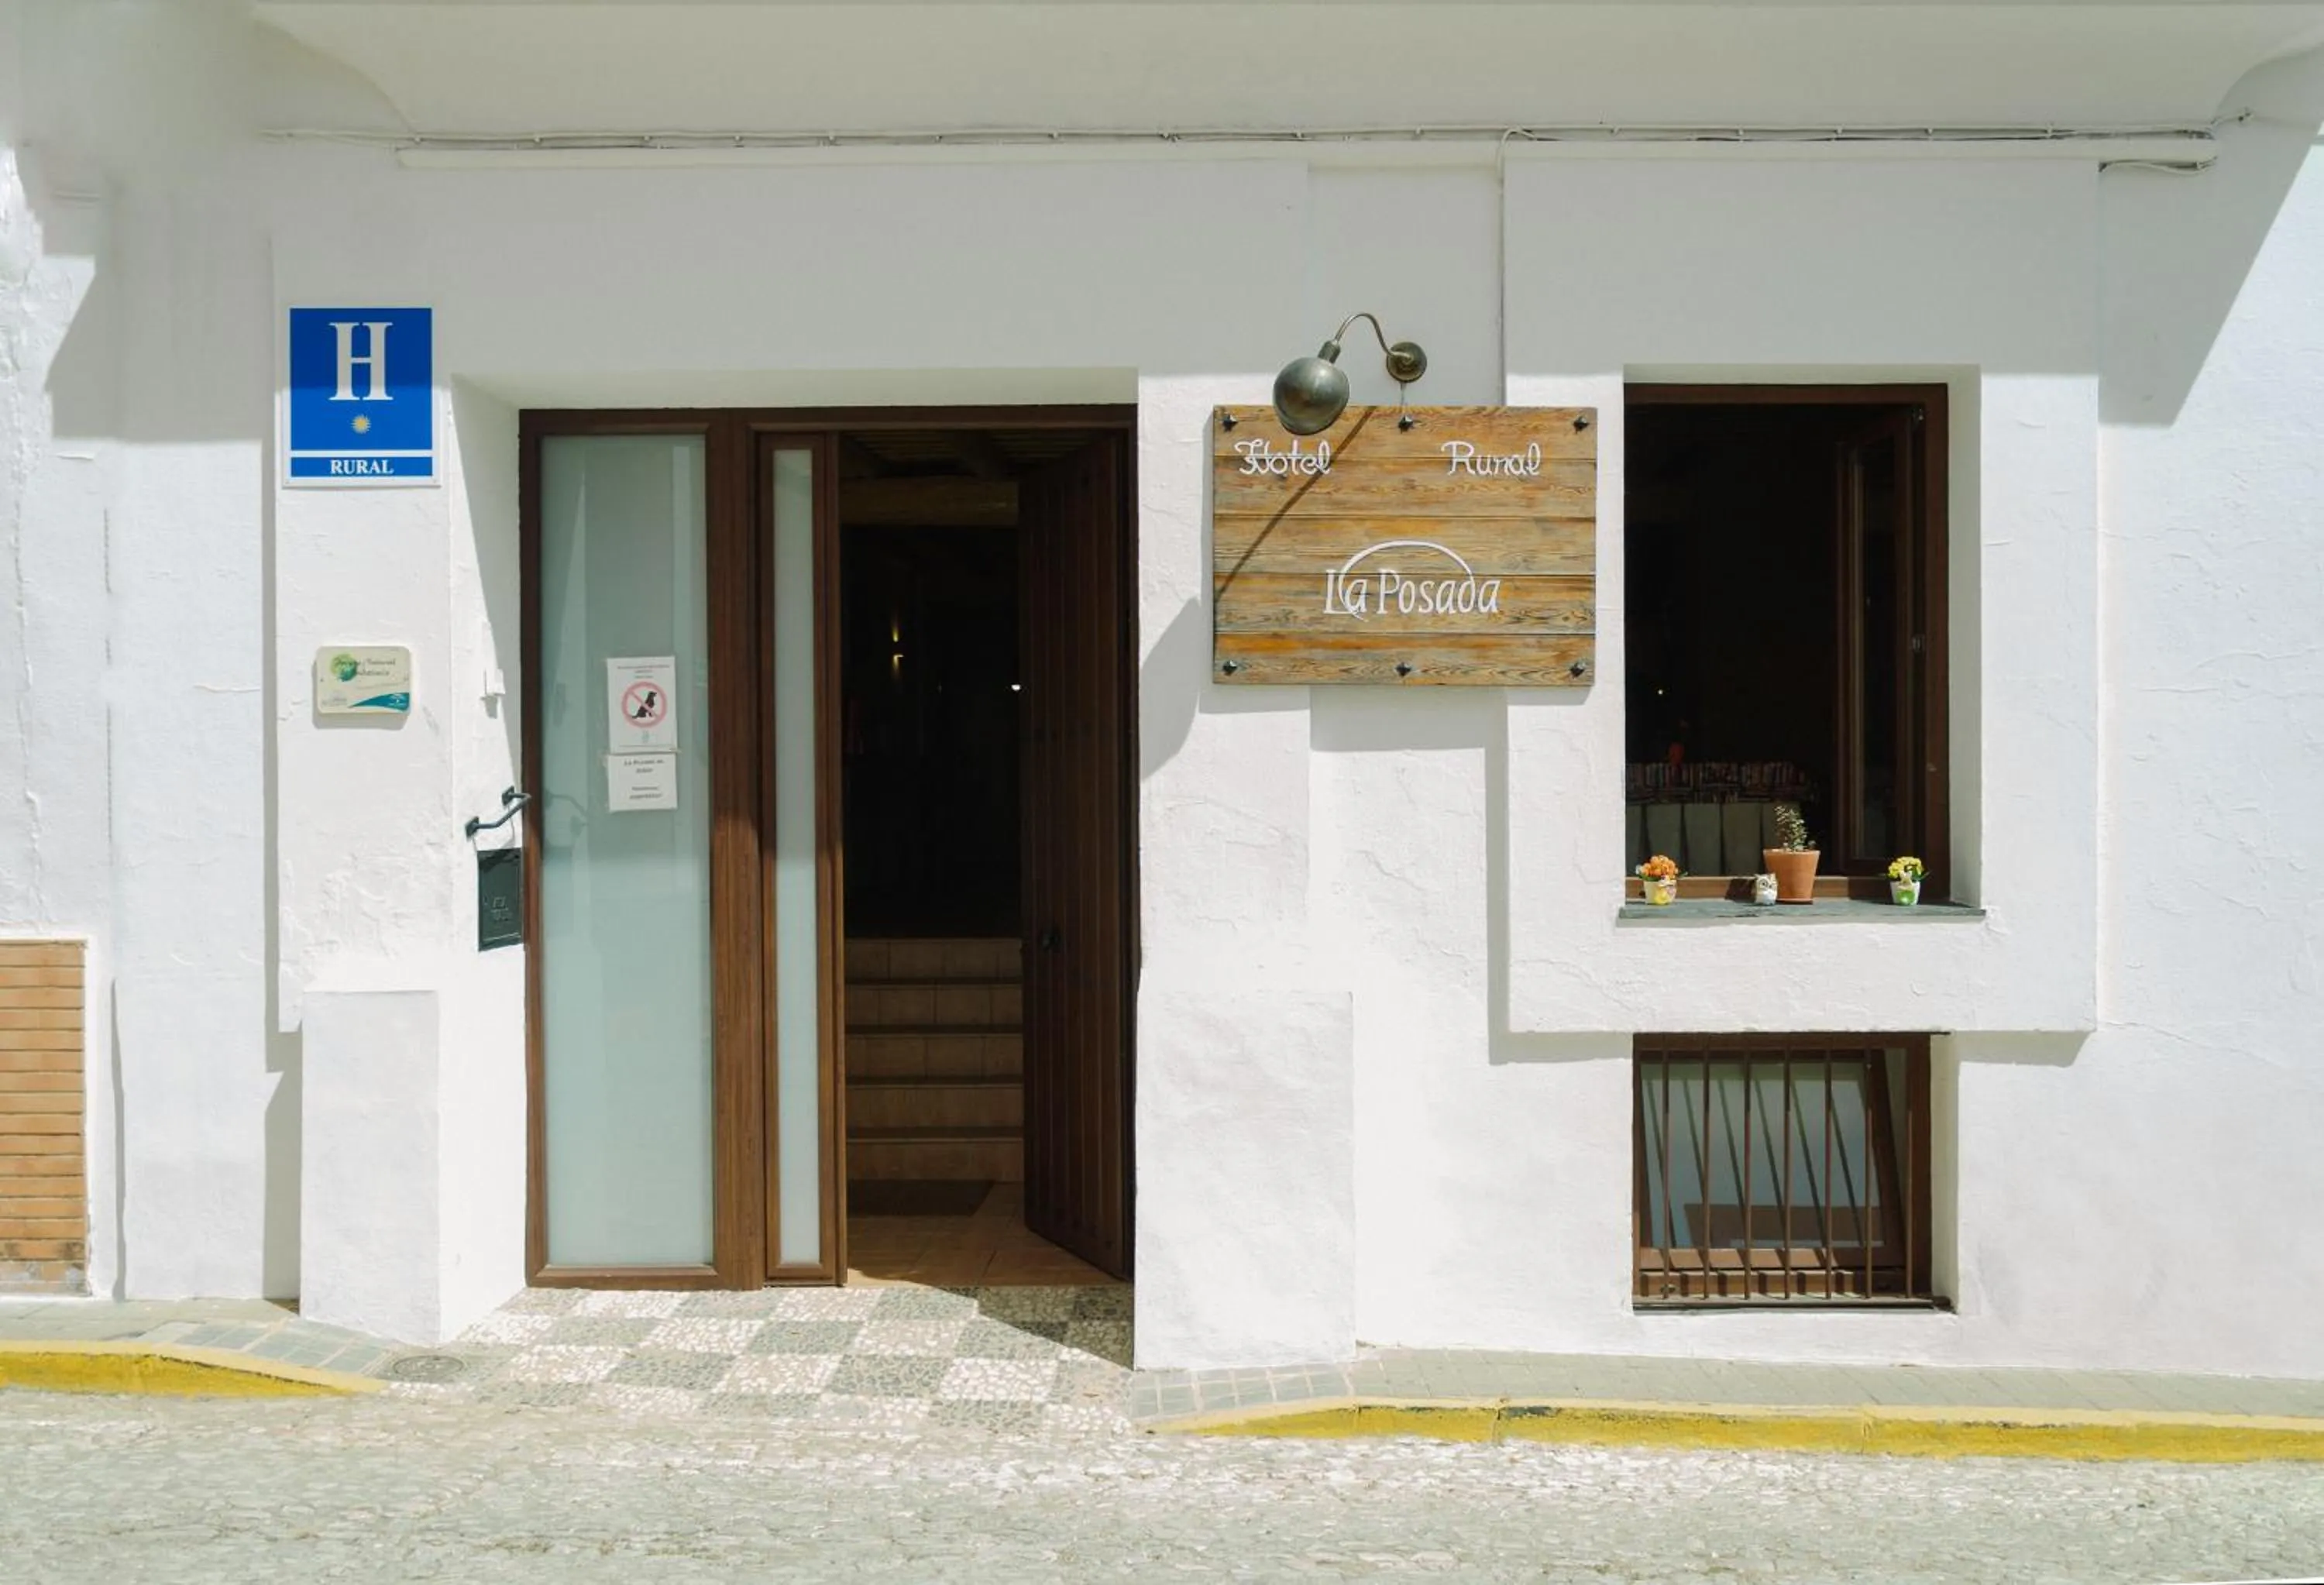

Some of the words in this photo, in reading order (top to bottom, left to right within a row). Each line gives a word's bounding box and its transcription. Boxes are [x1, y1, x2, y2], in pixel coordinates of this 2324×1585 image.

[328, 322, 393, 401] H
[331, 459, 394, 475] RURAL
[1235, 438, 1331, 475] Hotel
[1442, 442, 1541, 476] Rural
[1324, 569, 1368, 620] La
[1377, 569, 1501, 615] Posada
